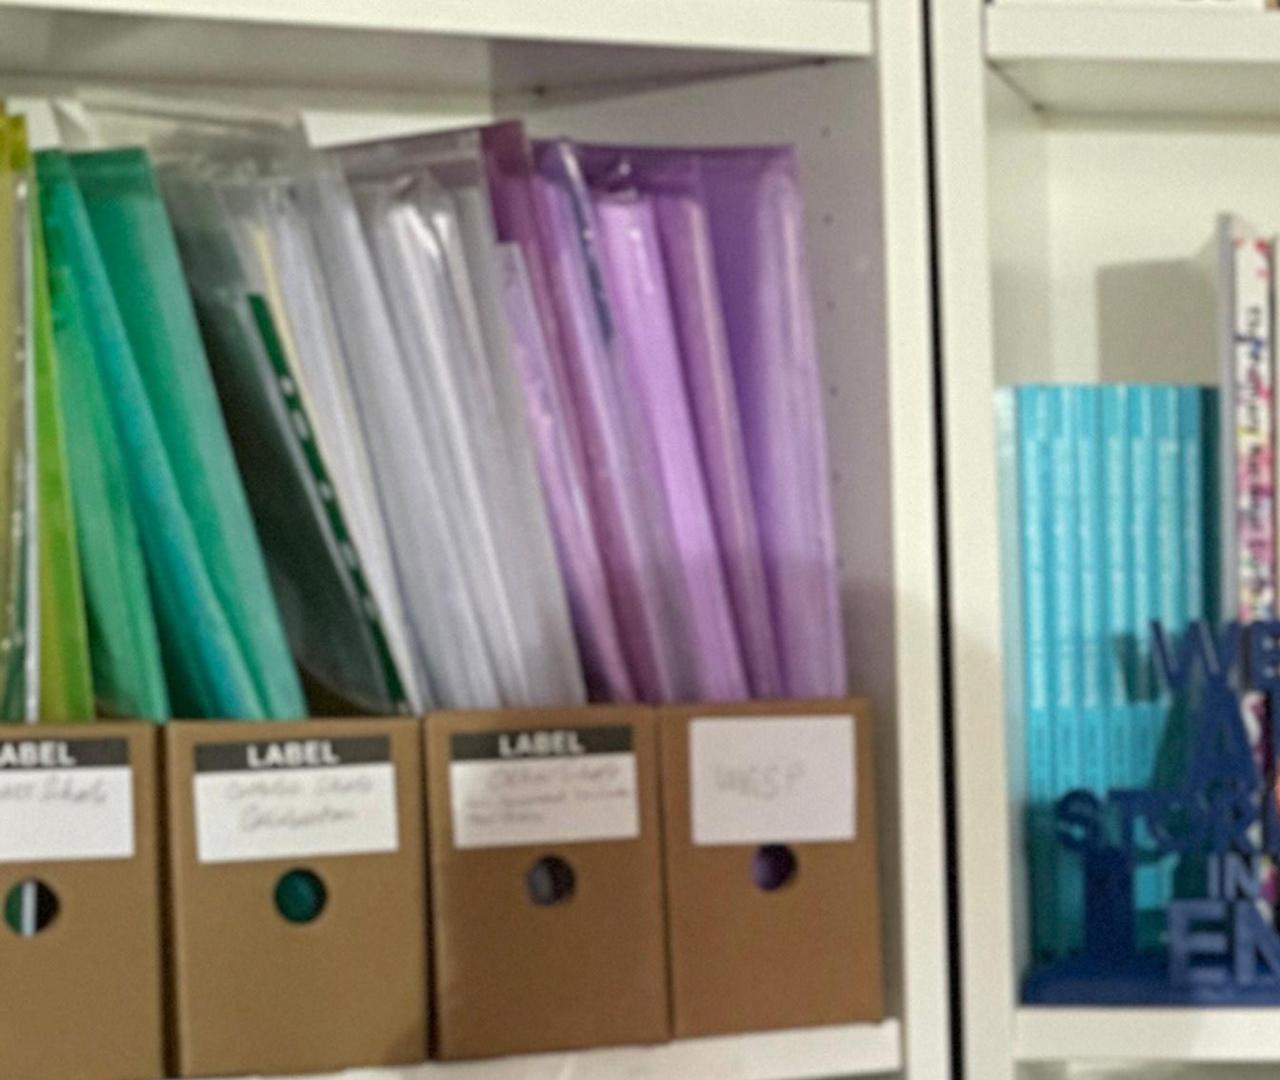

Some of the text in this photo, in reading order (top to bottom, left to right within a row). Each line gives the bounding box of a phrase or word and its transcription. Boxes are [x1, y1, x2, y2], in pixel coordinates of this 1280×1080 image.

[0, 741, 76, 767] ABEL
[246, 740, 341, 768] LABEL
[498, 731, 586, 758] LABEL
